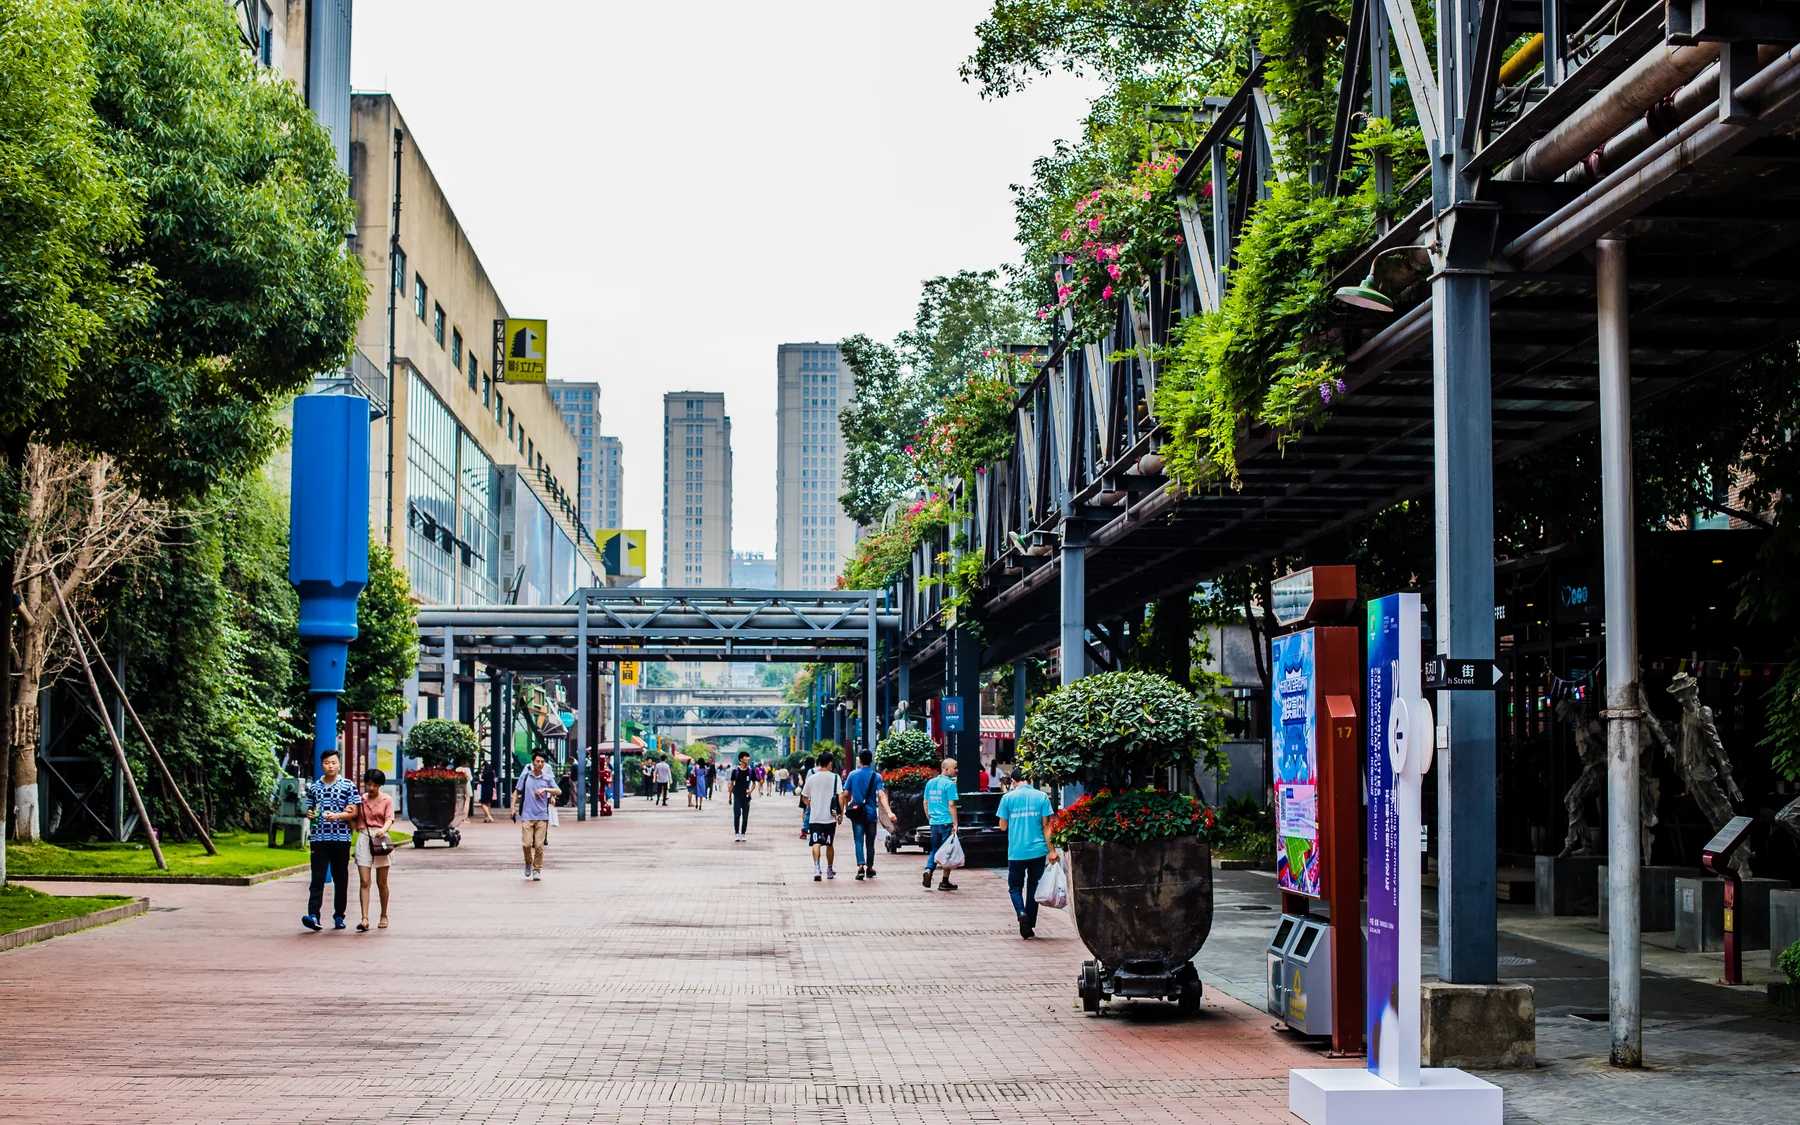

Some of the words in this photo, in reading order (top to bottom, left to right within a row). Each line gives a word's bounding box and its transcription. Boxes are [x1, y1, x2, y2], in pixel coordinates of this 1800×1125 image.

[507, 359, 544, 374] 影立方
[1424, 660, 1437, 676] 东大门
[1461, 664, 1475, 678] 街
[1453, 677, 1475, 685] Street
[1336, 726, 1353, 739] 17
